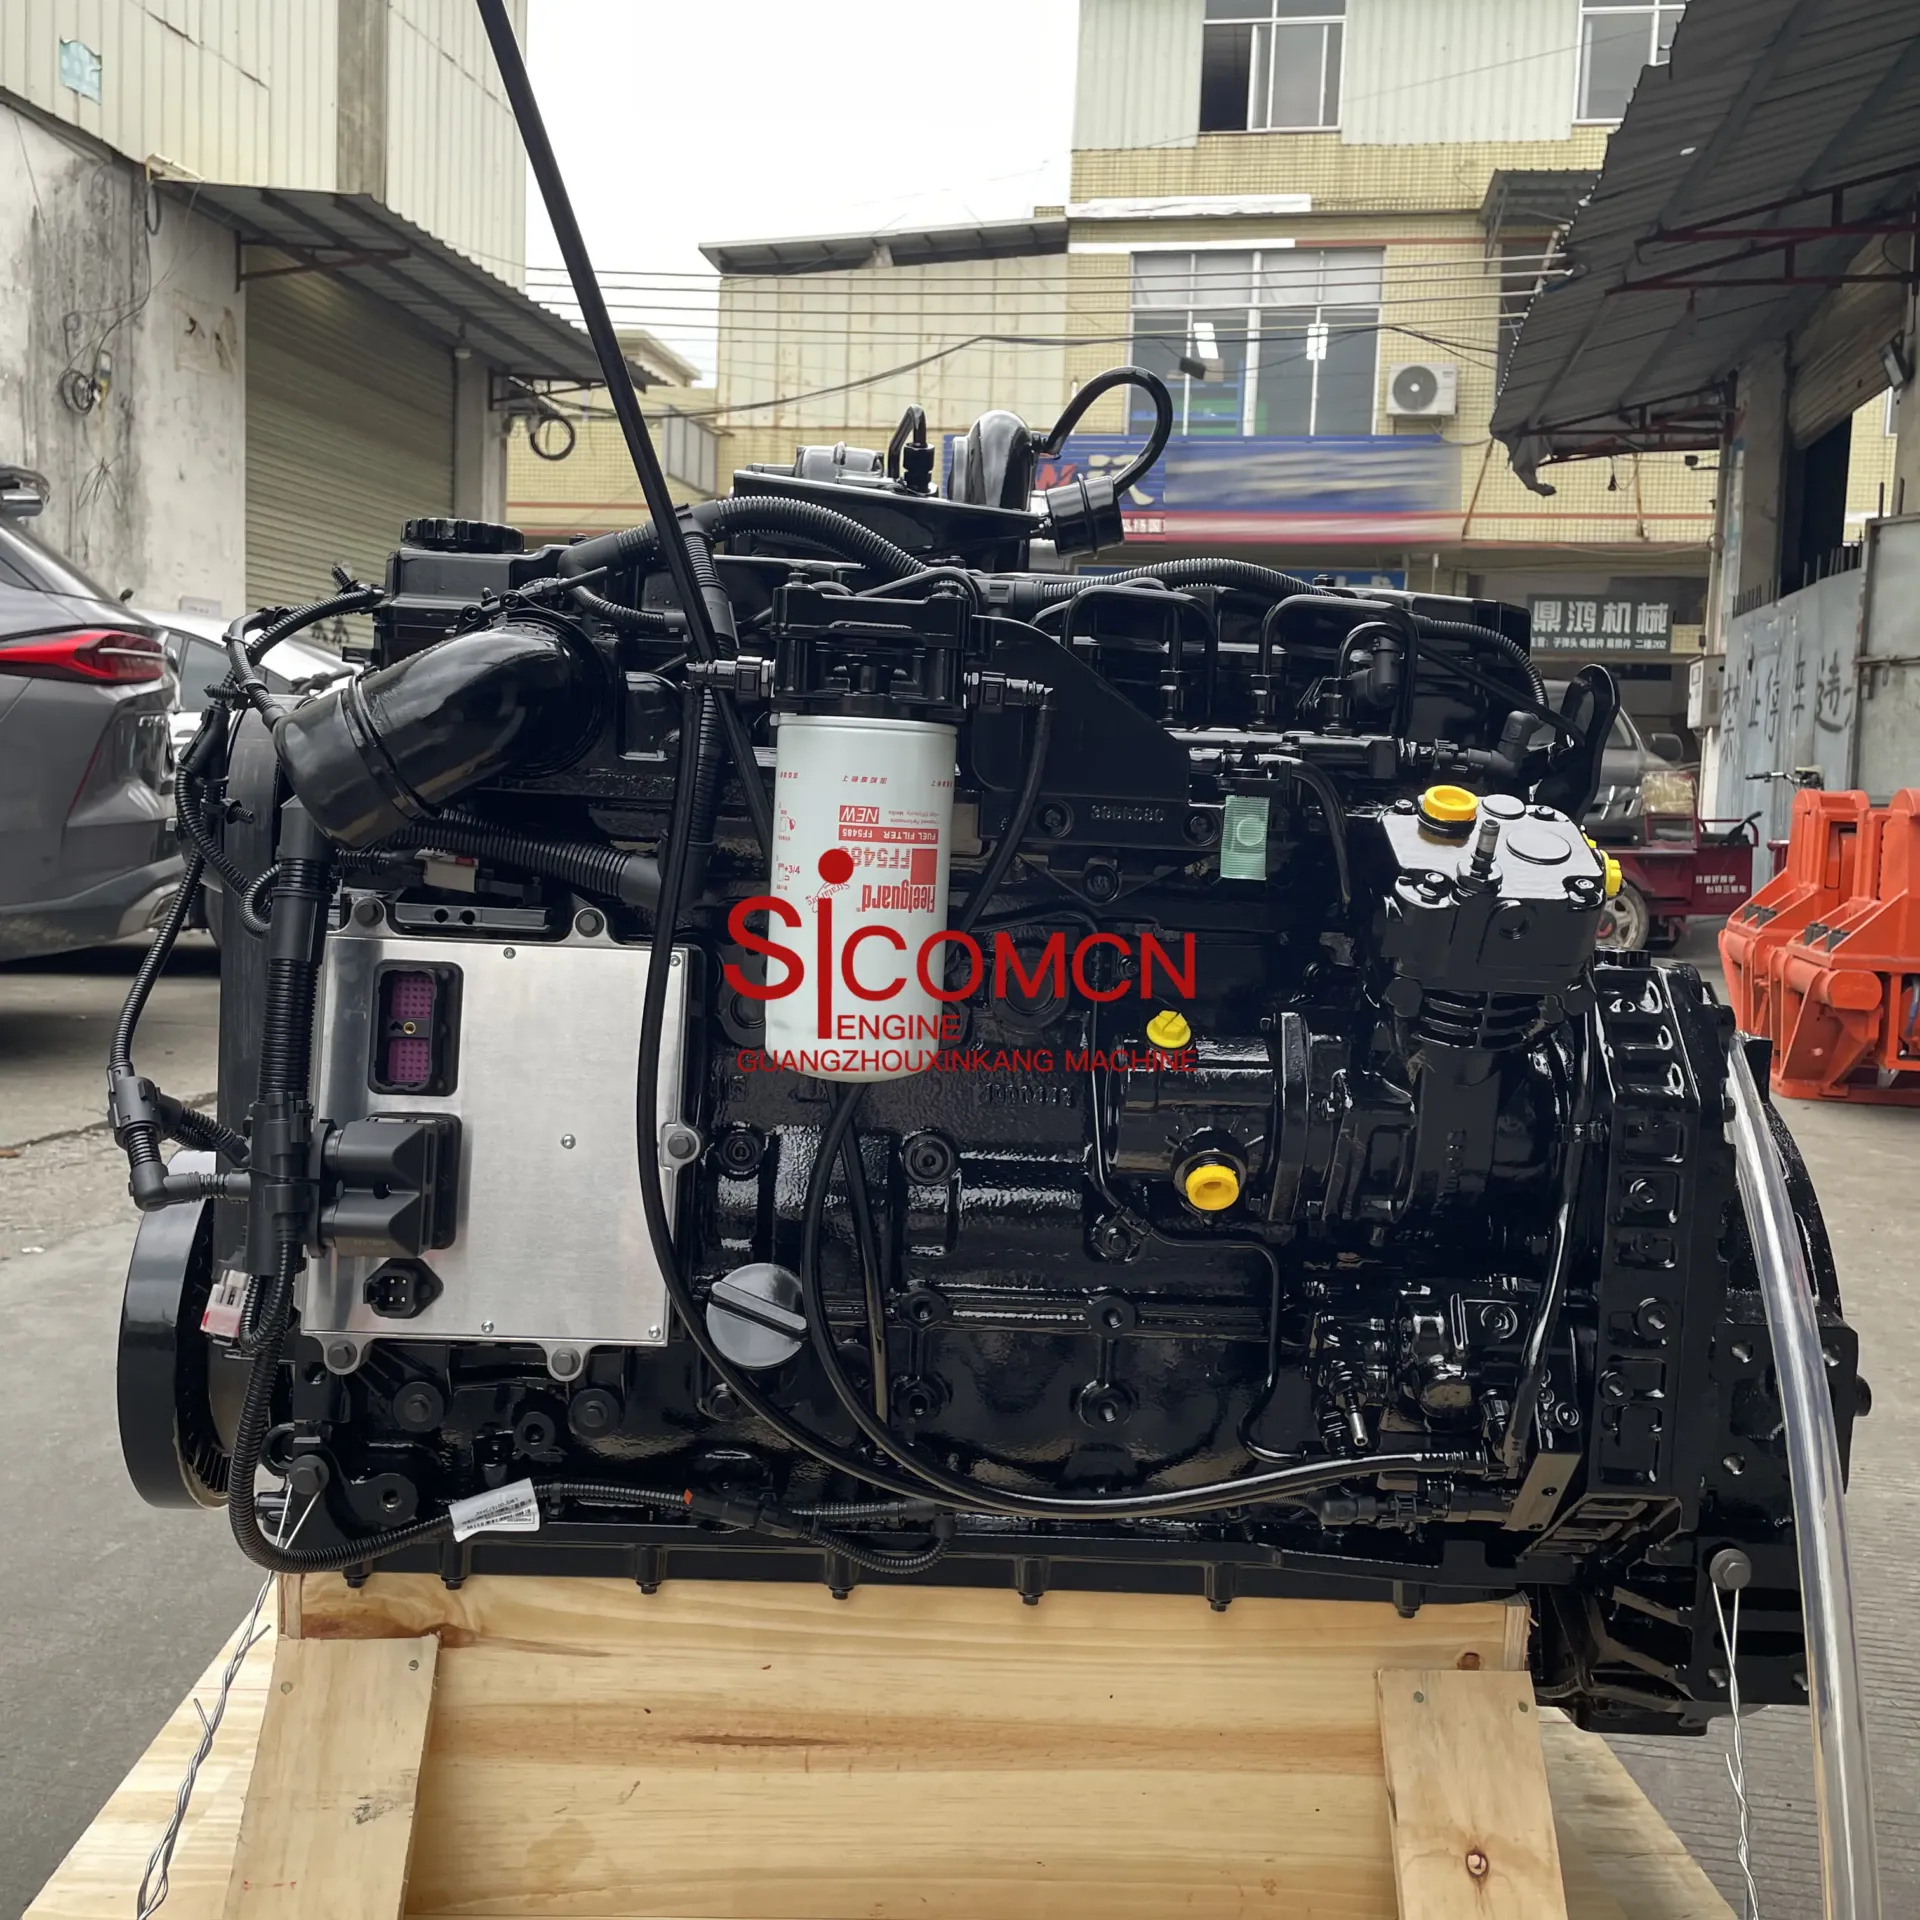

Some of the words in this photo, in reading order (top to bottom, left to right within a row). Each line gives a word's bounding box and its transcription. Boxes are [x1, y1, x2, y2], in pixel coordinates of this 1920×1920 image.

[1532, 601, 1669, 634] 鼎鸿机械
[841, 807, 879, 823] NEW
[842, 828, 872, 838] FF5485
[883, 831, 915, 840] FILTER
[918, 832, 936, 841] FUEL
[862, 880, 936, 913] Fleetguard
